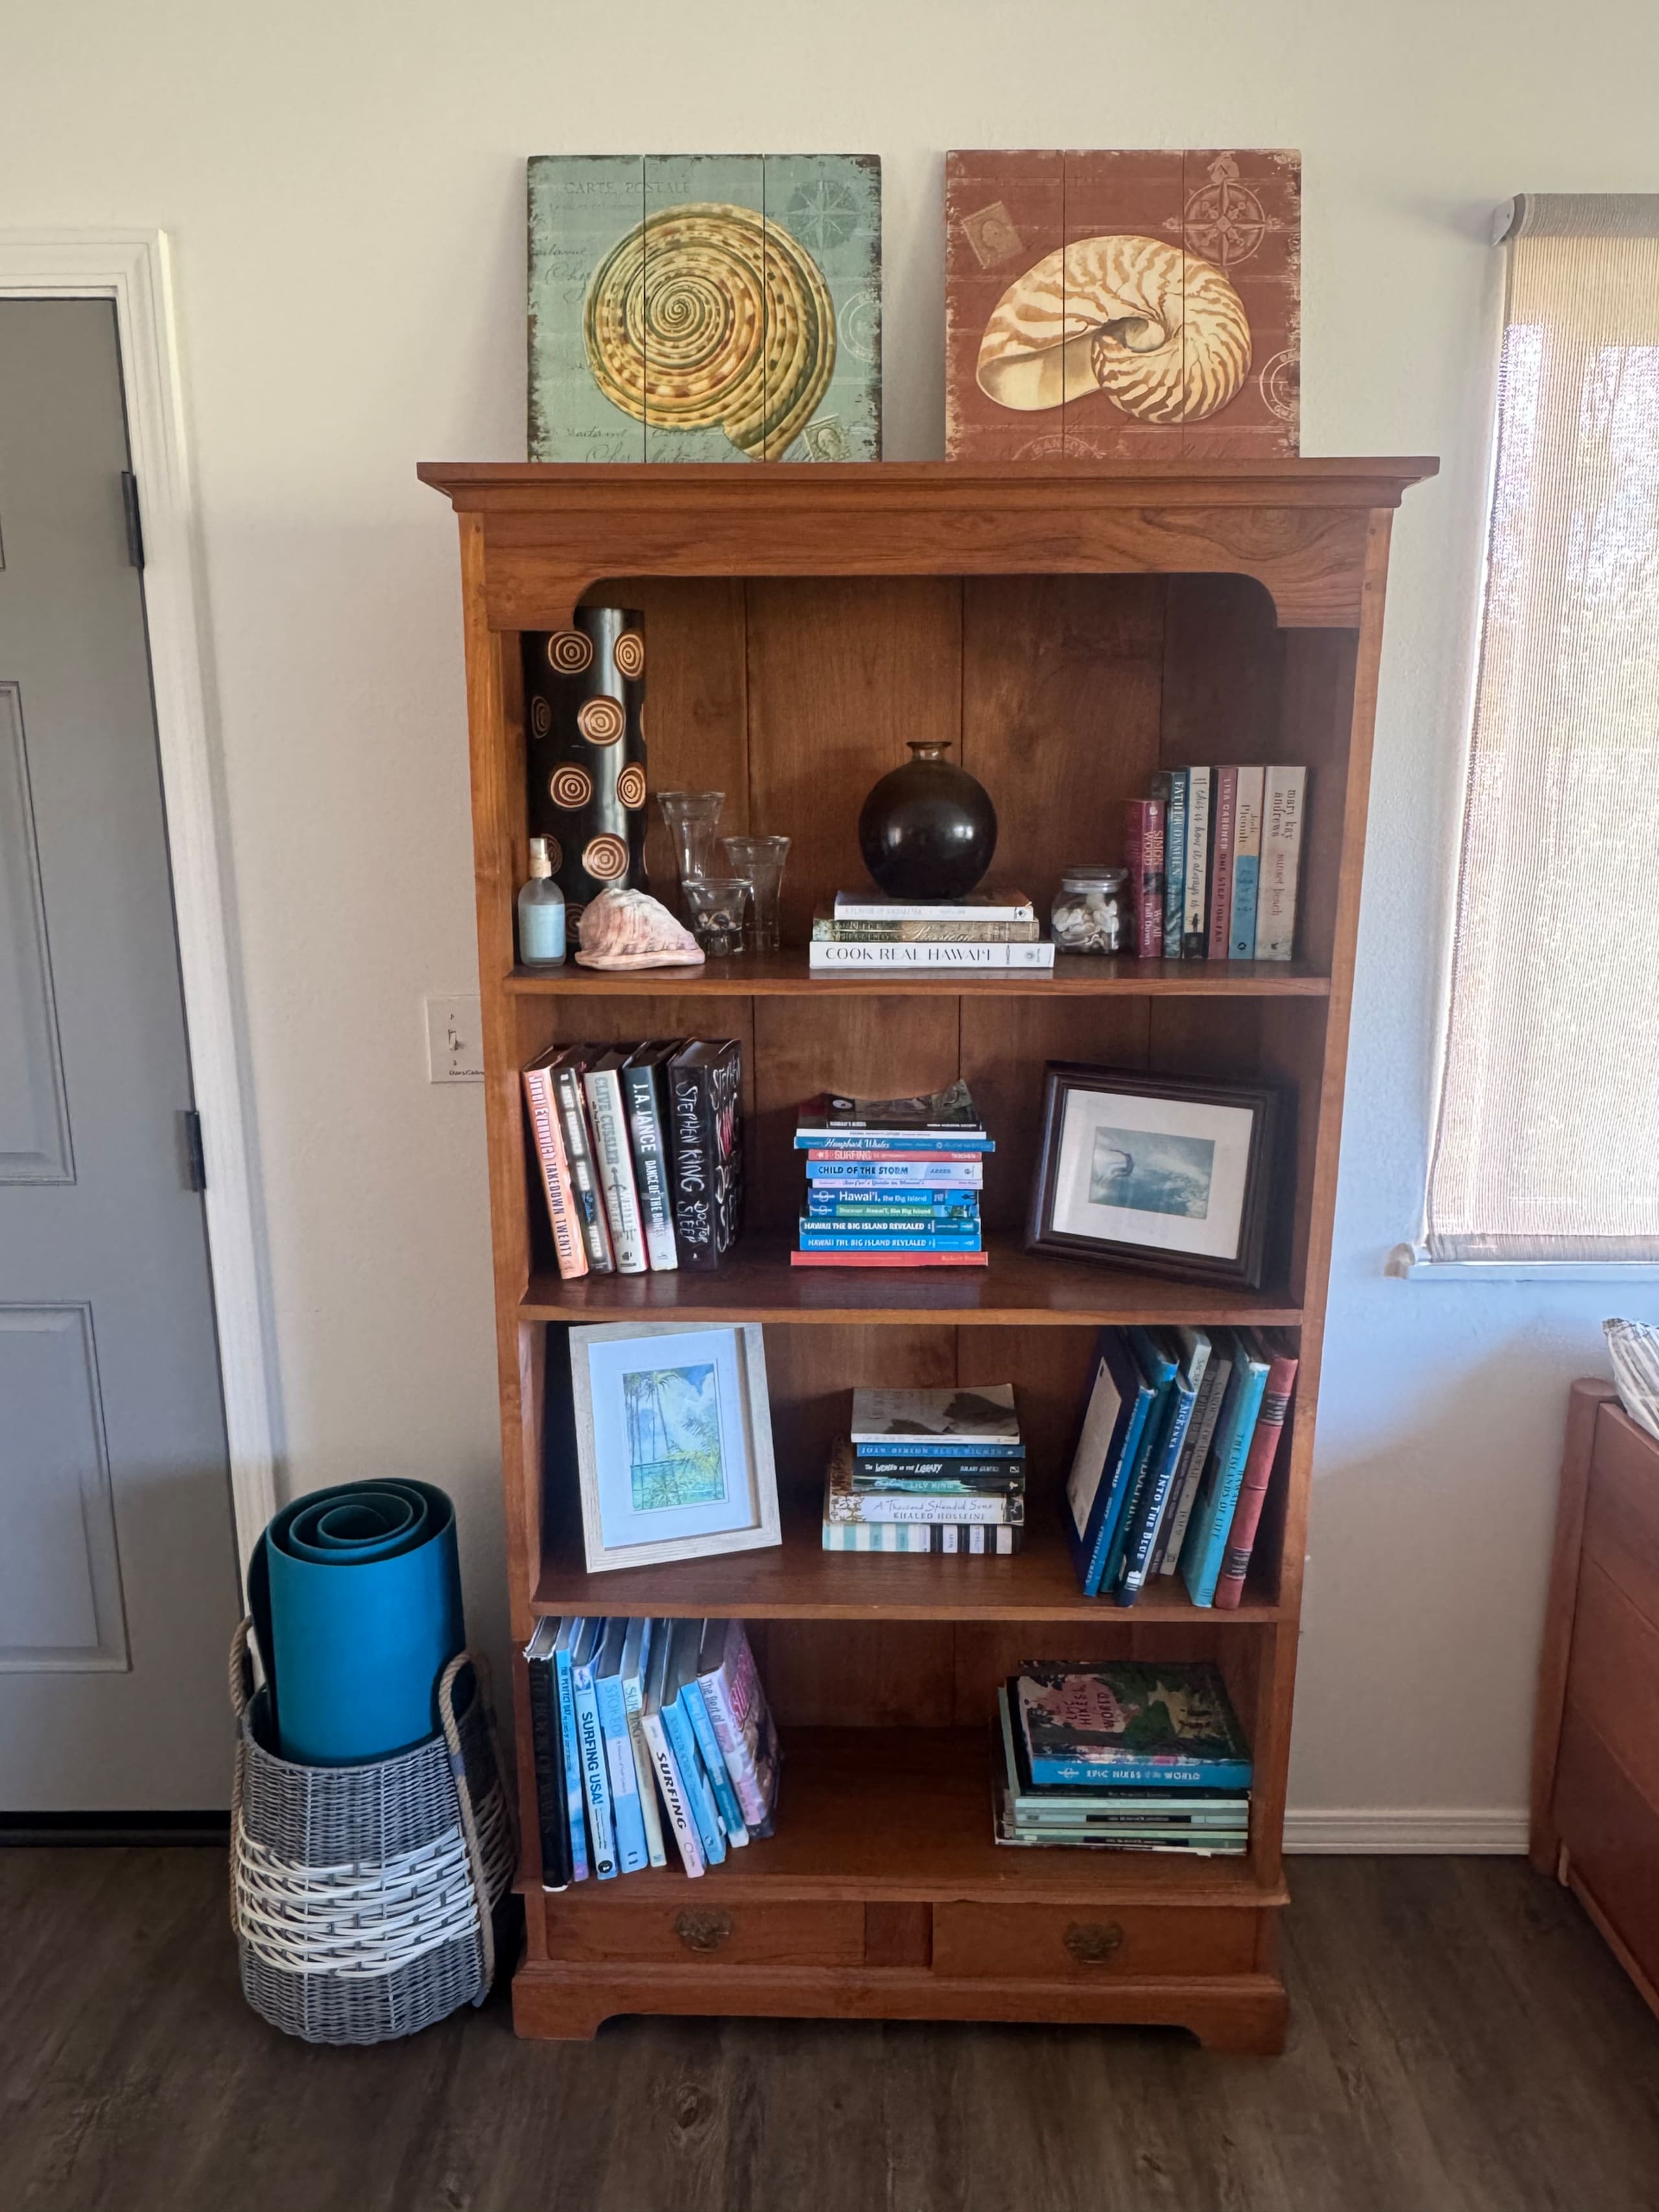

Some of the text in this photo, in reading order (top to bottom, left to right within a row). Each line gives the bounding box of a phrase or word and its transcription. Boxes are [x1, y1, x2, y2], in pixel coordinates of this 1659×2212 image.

[1174, 781, 1184, 825] FATHER
[1195, 789, 1207, 809] this
[1223, 778, 1231, 800] LISA
[1220, 804, 1231, 850] GARDNER
[1271, 792, 1287, 837] andrews
[1281, 789, 1297, 840] mary kay
[1144, 831, 1152, 866] WOOD
[1154, 830, 1163, 866] SIMON
[1172, 829, 1183, 877] DAMIEN
[1194, 826, 1205, 848] how
[1187, 863, 1202, 896] always
[1271, 853, 1286, 916] sunset beach
[1154, 909, 1161, 922] We
[826, 947, 873, 960] COOK
[880, 948, 918, 960] REAL
[595, 1077, 620, 1165] CLIVE CUSSLER
[638, 1112, 656, 1152] JANCE
[675, 1080, 705, 1192] STEPHEN KING
[823, 1138, 863, 1148] Humpback
[864, 1139, 889, 1148] Whales
[834, 1150, 872, 1159] SURFING
[644, 1160, 658, 1183] DANCE
[546, 1162, 564, 1215] TAKEDOWN
[556, 1218, 572, 1258] TWENTY
[649, 1194, 661, 1209] THE
[694, 1200, 712, 1244] DOCTOR
[677, 1202, 696, 1244] SLEEP
[1137, 1474, 1170, 1560] INTO THE BLUE
[701, 1679, 712, 1695] The
[706, 1695, 719, 1716] Best
[626, 1686, 644, 1740] SURFING
[581, 1711, 599, 1772] SURFING
[590, 1769, 603, 1805] USA!
[655, 1752, 687, 1830] SURFING
